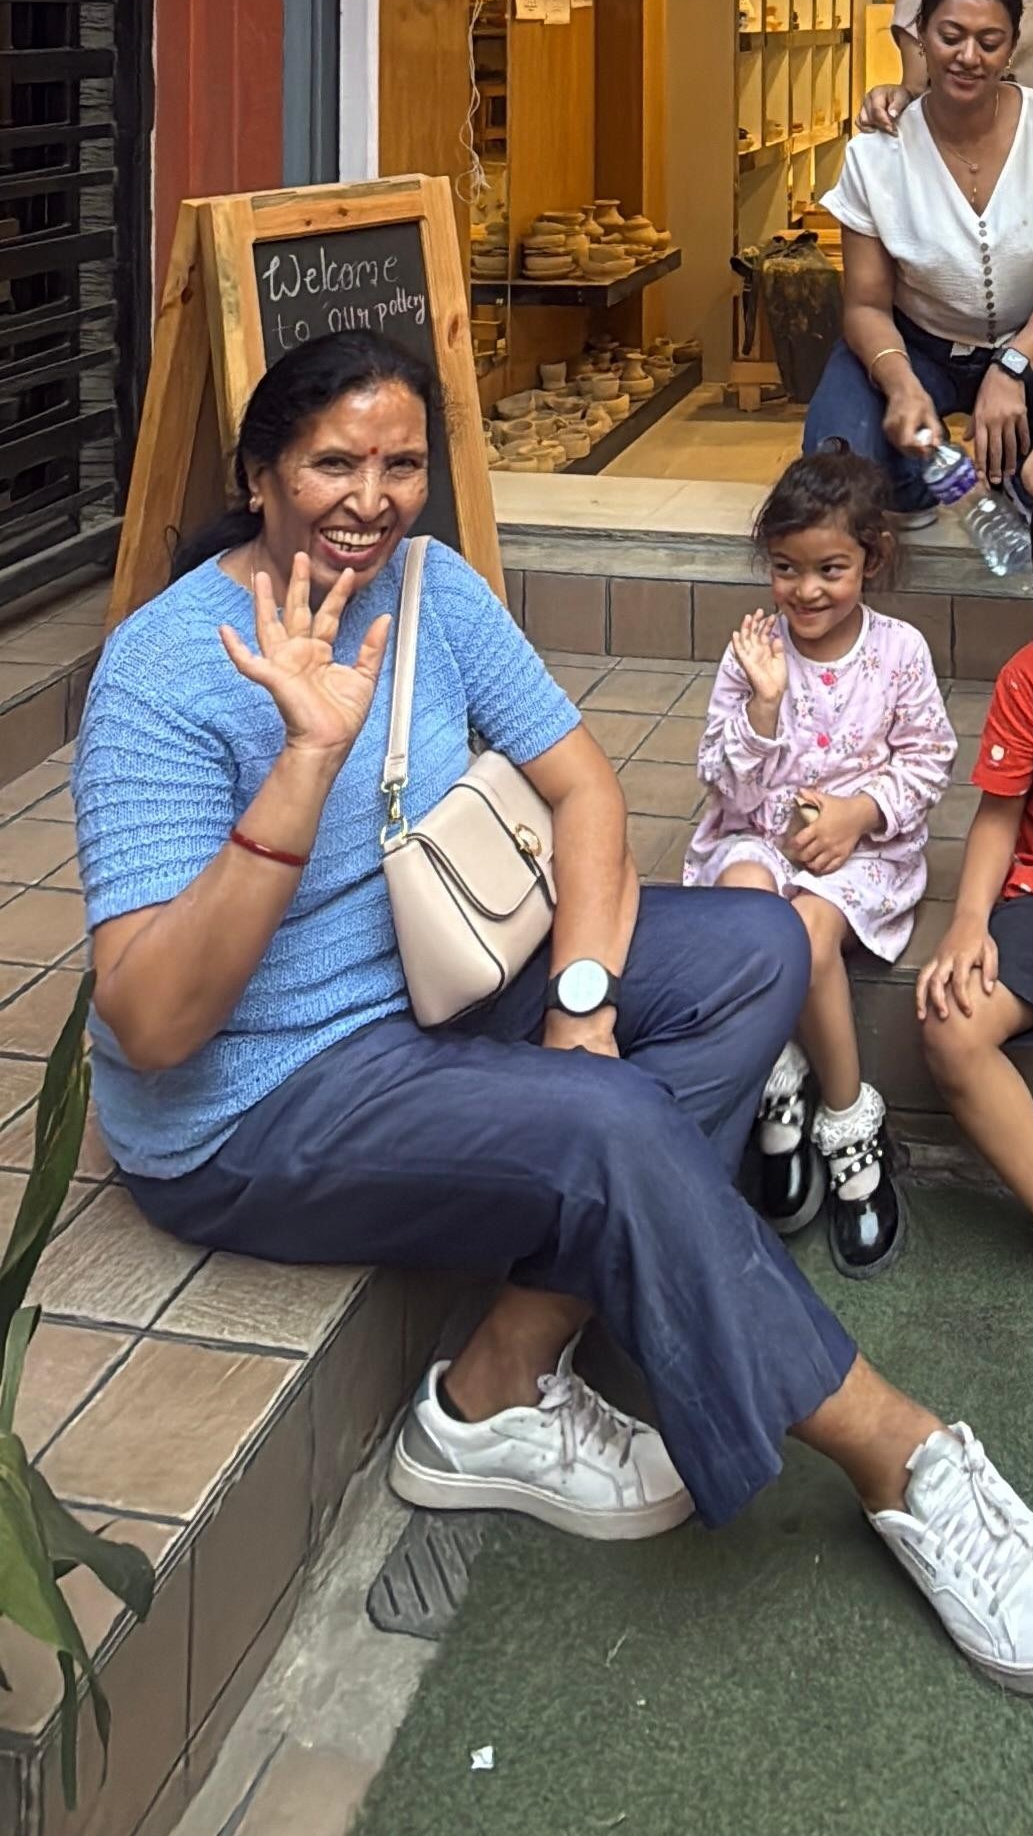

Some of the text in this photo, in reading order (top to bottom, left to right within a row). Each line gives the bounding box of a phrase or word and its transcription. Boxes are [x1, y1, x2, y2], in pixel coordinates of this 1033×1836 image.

[262, 247, 400, 302] Welcome
[272, 314, 310, 351] to
[327, 307, 372, 335] our
